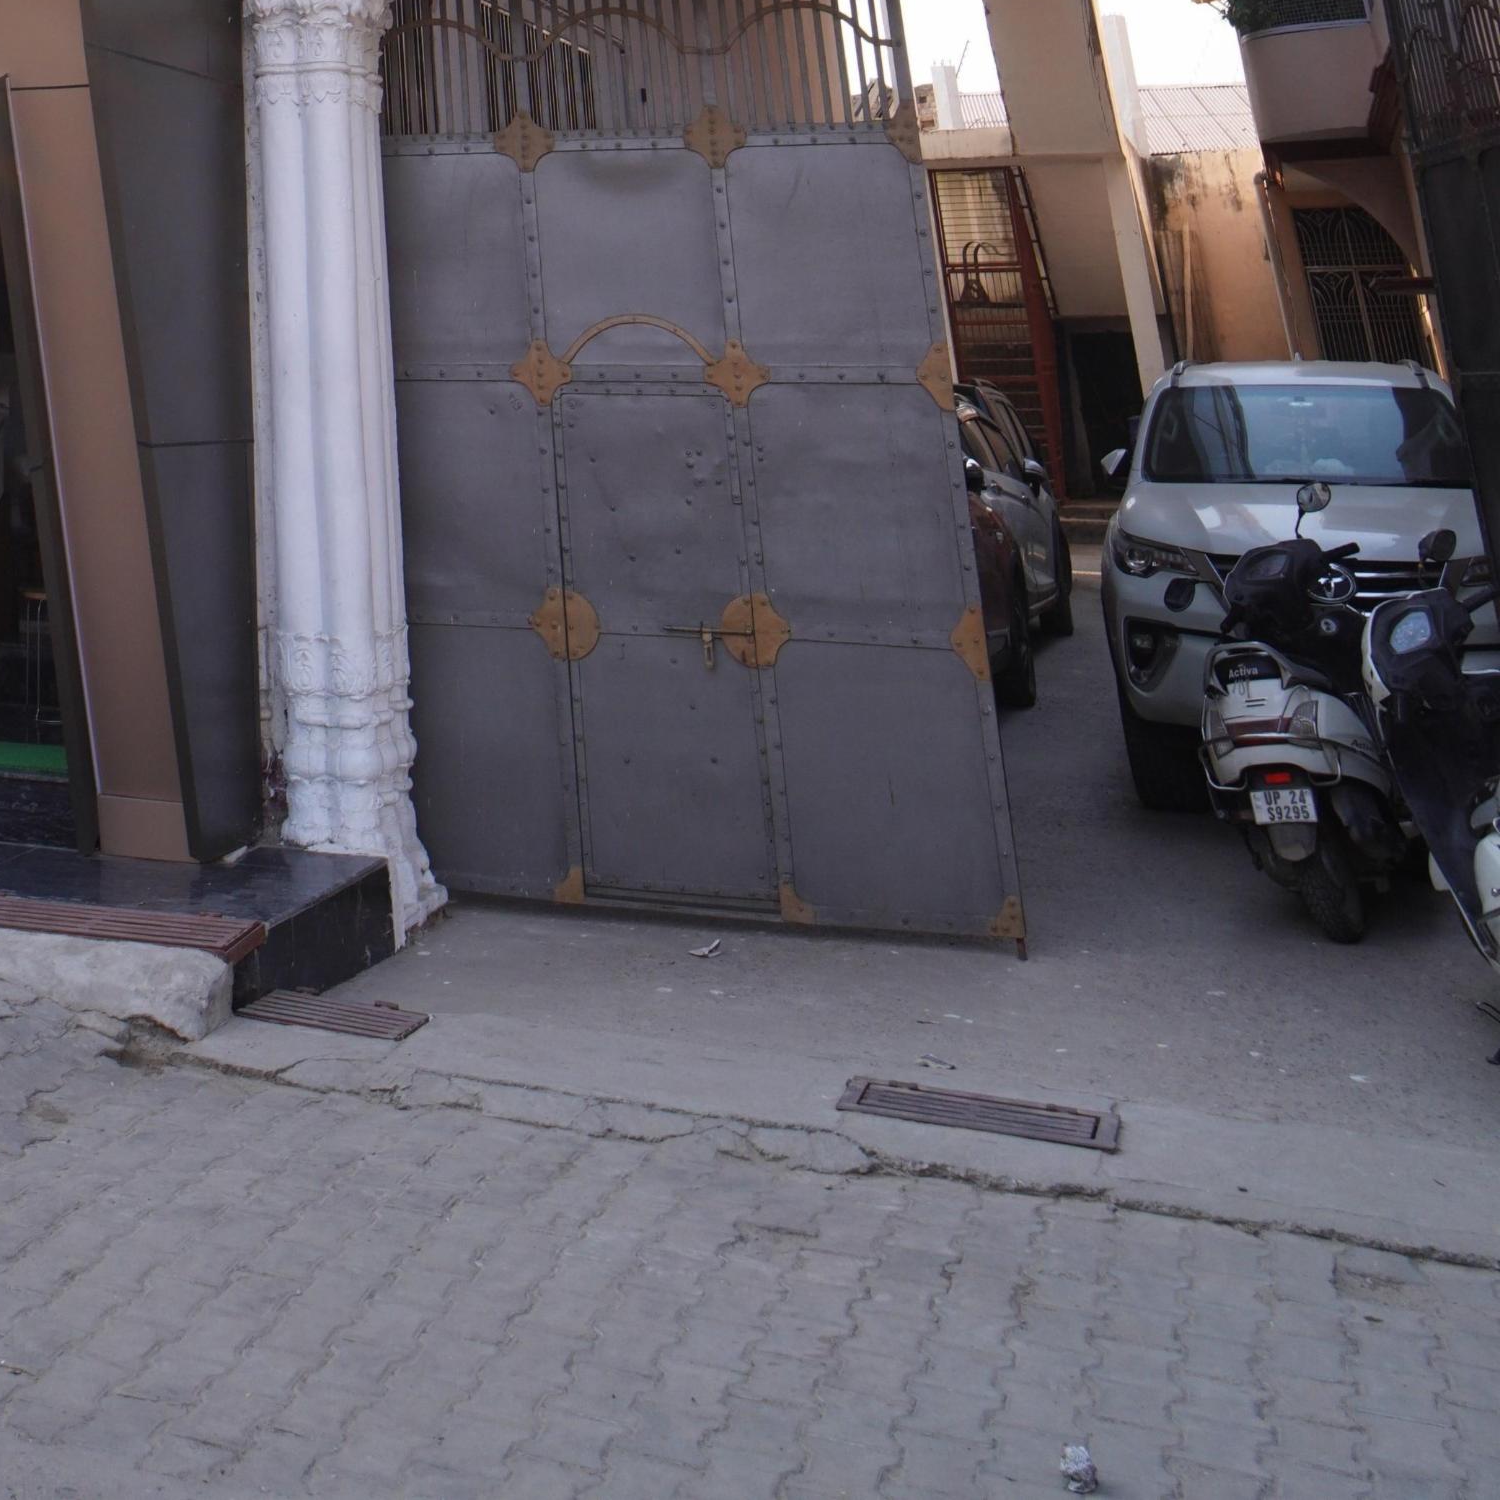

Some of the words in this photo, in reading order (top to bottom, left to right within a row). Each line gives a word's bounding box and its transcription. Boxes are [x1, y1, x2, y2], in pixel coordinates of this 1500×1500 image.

[1228, 666, 1258, 680] Activa
[1263, 791, 1280, 806] UP
[1290, 791, 1306, 805] 24
[1268, 805, 1310, 821] S9295
